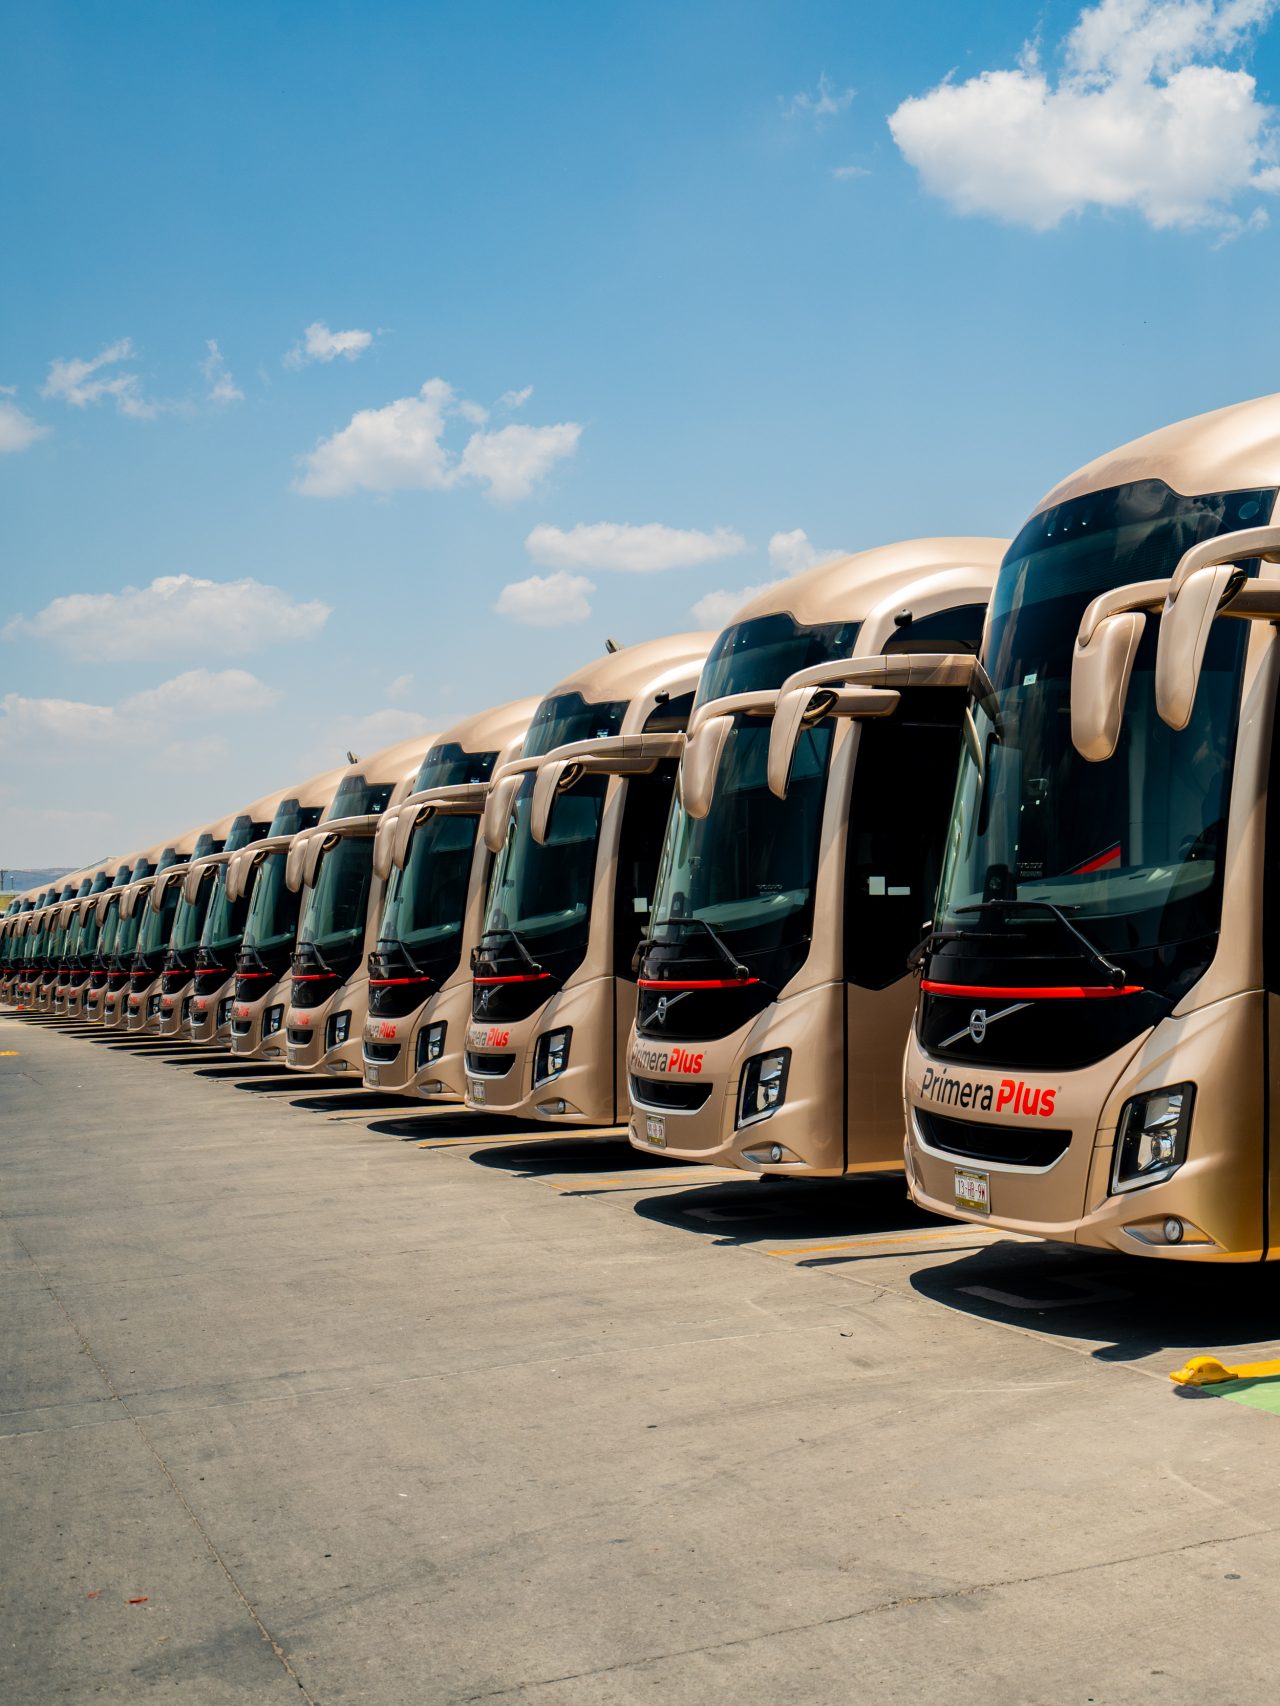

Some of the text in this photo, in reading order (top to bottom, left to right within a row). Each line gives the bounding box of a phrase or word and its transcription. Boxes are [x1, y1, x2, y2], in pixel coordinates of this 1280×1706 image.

[667, 1047, 704, 1074] Plus
[920, 1067, 1057, 1117] Primera Plus
